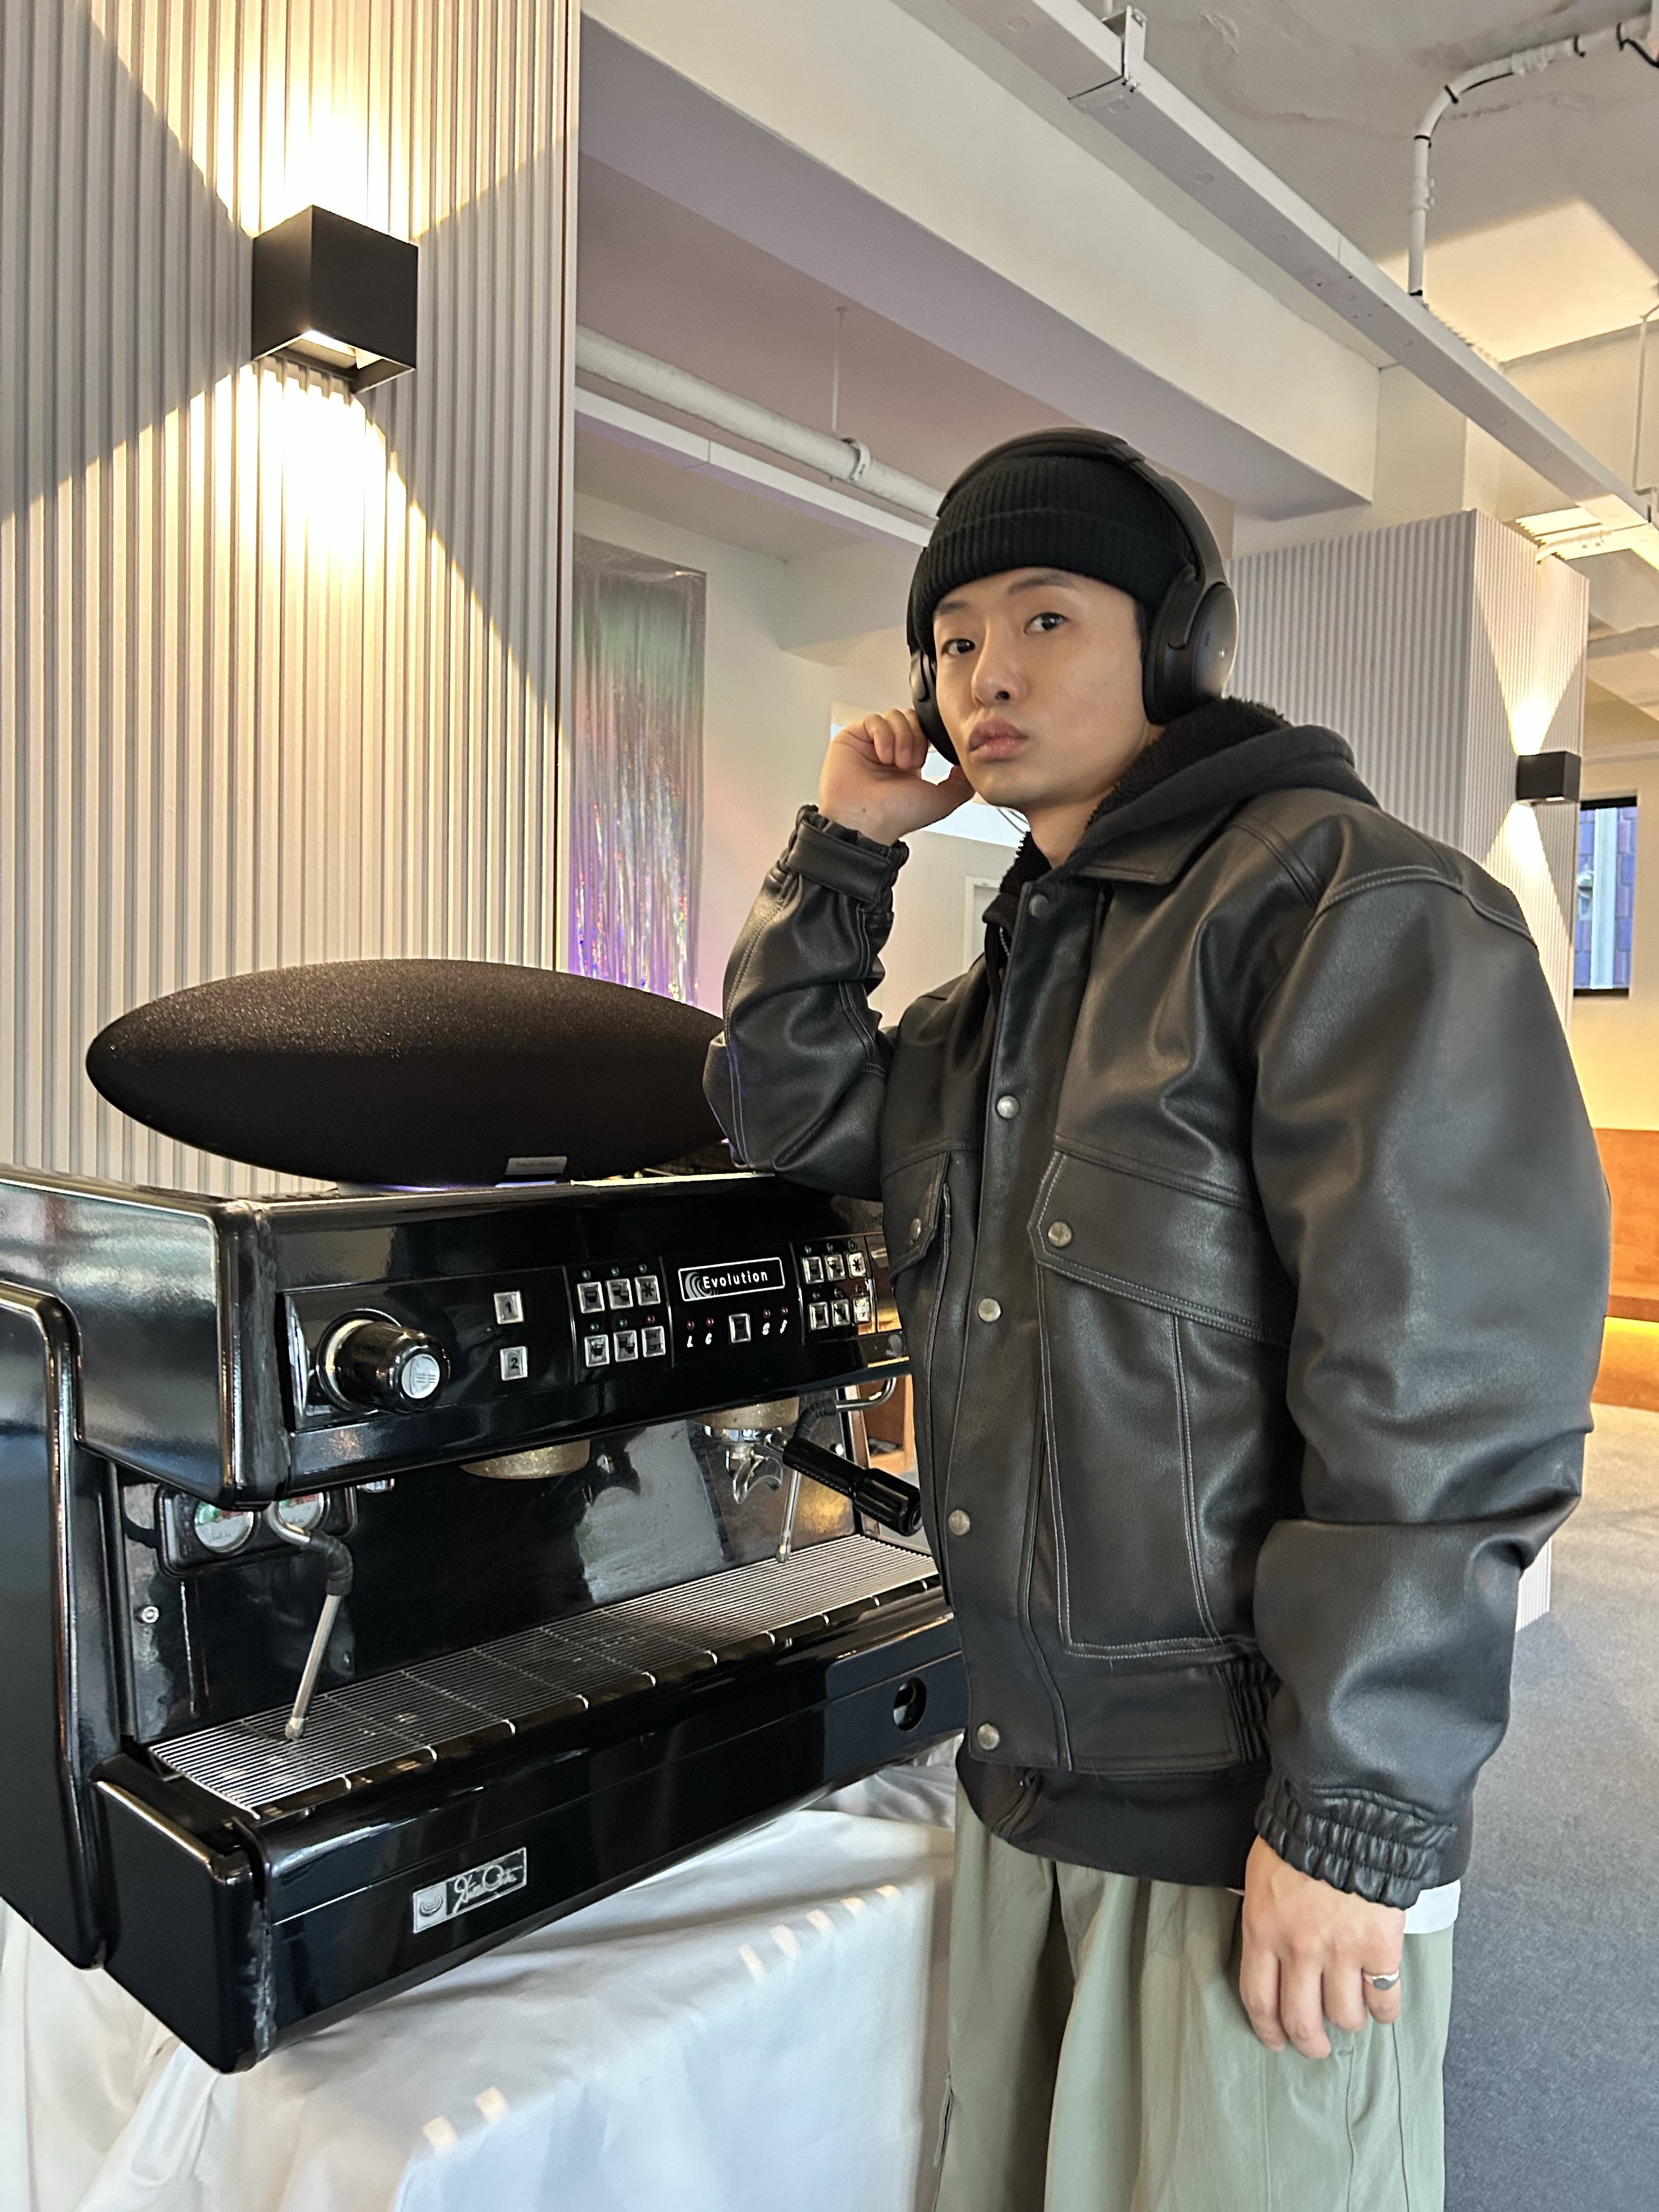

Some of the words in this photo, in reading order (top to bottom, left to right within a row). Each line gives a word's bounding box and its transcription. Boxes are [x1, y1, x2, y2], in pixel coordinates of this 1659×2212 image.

[702, 1269, 770, 1289] Evolution
[504, 1301, 512, 1313] 1
[762, 1322, 770, 1335] S
[511, 1357, 520, 1369] 2
